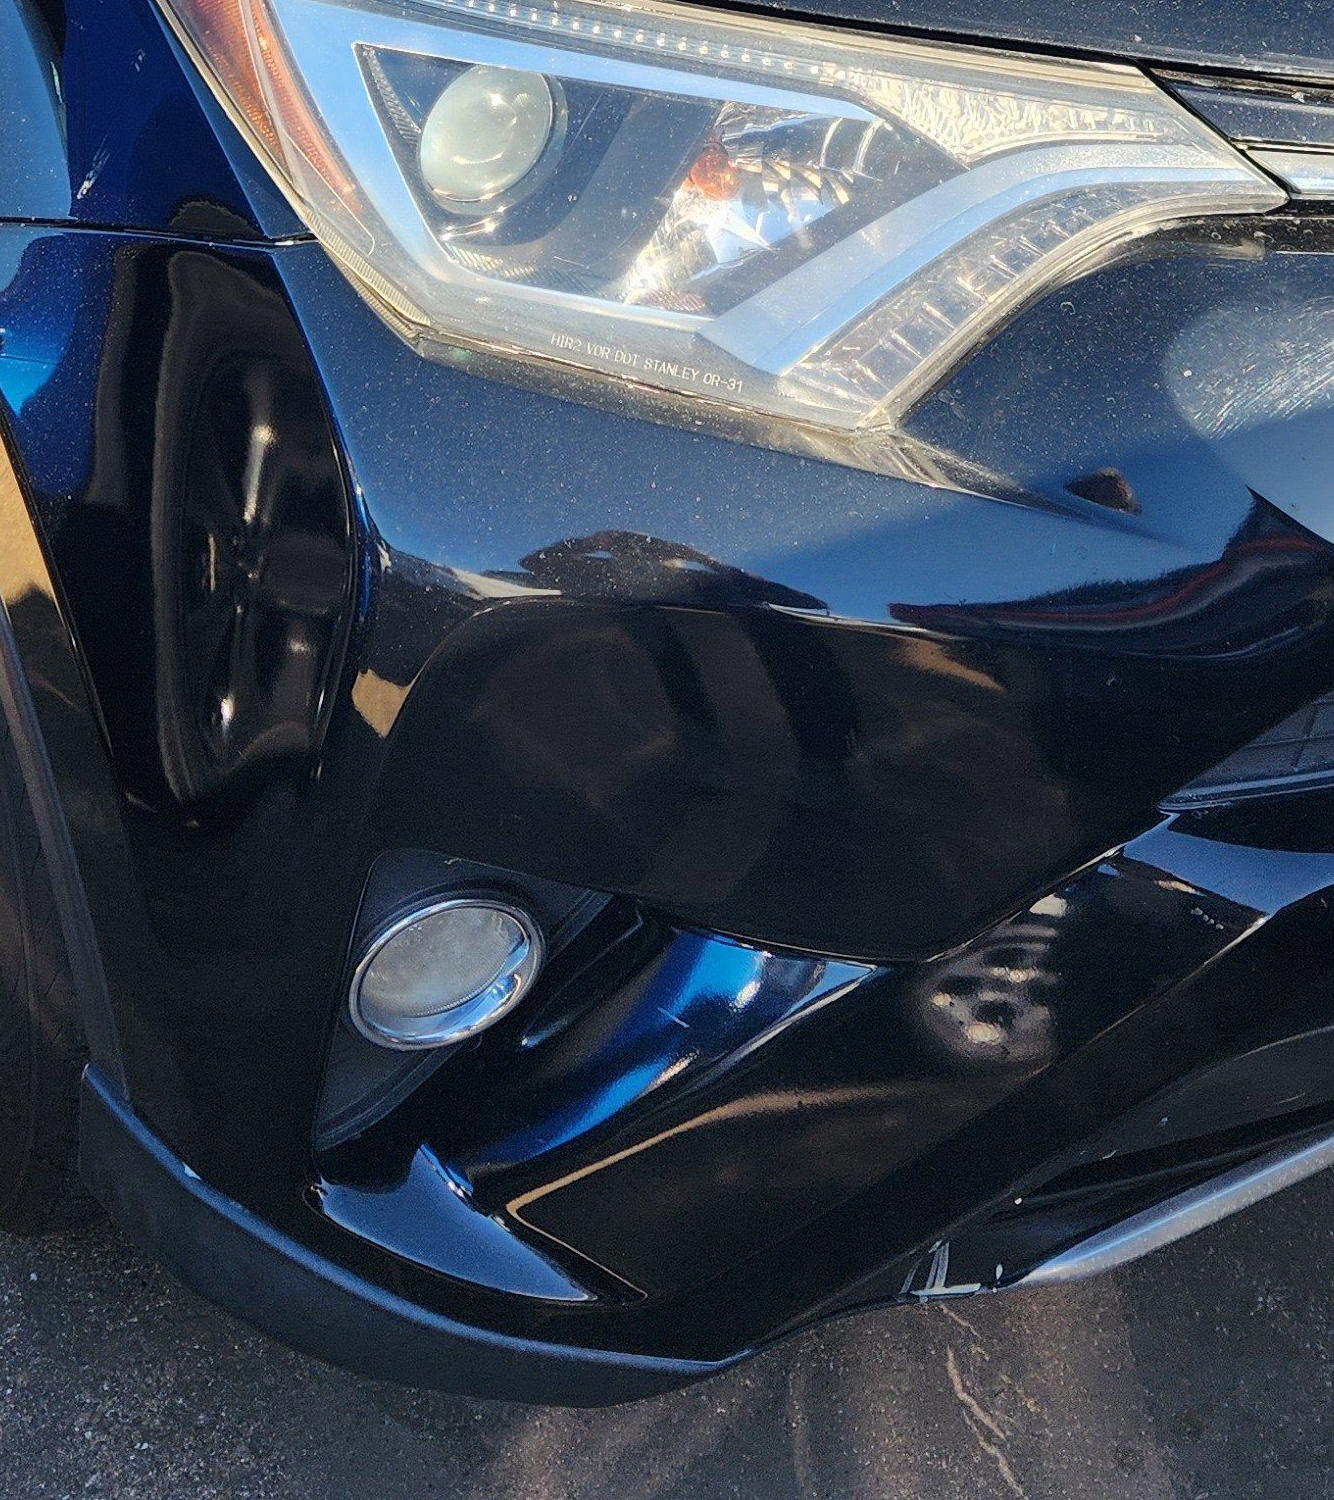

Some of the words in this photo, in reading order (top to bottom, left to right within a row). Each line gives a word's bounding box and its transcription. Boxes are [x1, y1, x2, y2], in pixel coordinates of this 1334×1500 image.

[550, 333, 582, 353] HIR2
[586, 342, 609, 359] VOR
[614, 350, 641, 366] DOT
[643, 358, 700, 382] STANLEY
